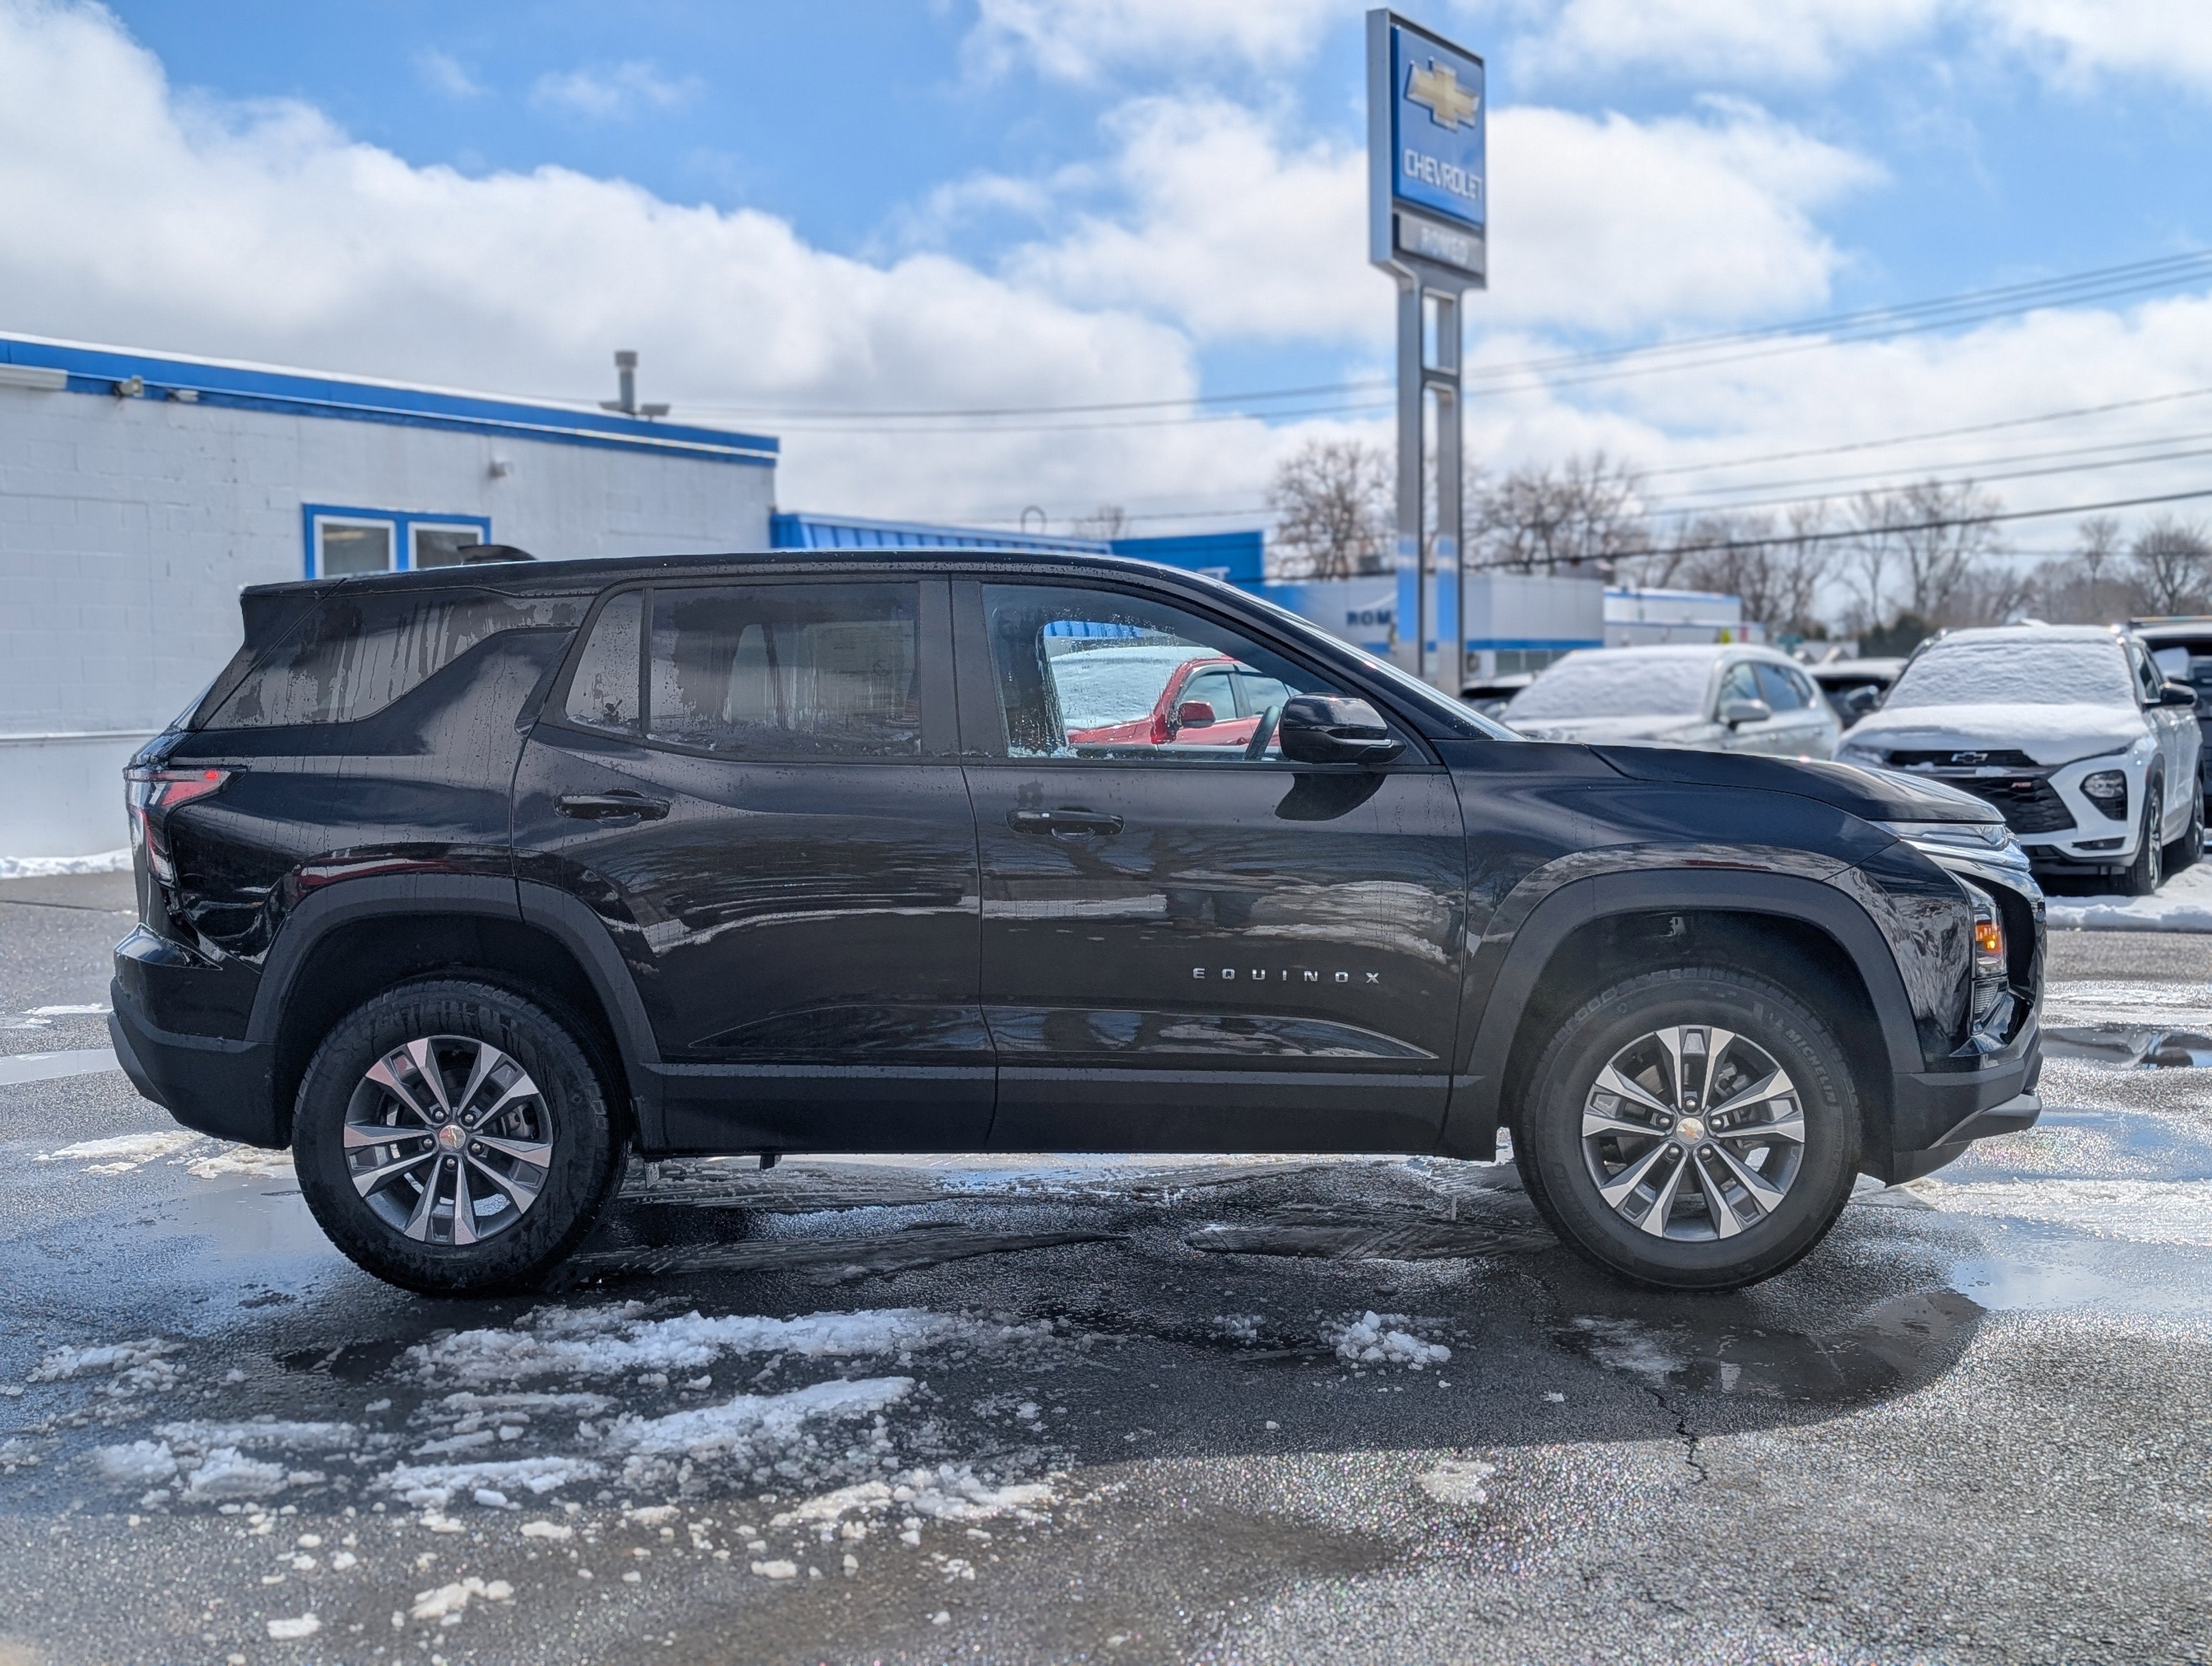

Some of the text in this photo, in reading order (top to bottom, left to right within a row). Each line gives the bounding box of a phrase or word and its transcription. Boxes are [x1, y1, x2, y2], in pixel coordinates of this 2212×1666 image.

[1404, 148, 1483, 201] CHEVROLET
[1347, 611, 1392, 626] ROM
[1193, 967, 1379, 984] EQUINOX
[1786, 1029, 1837, 1103] MICHELIN
